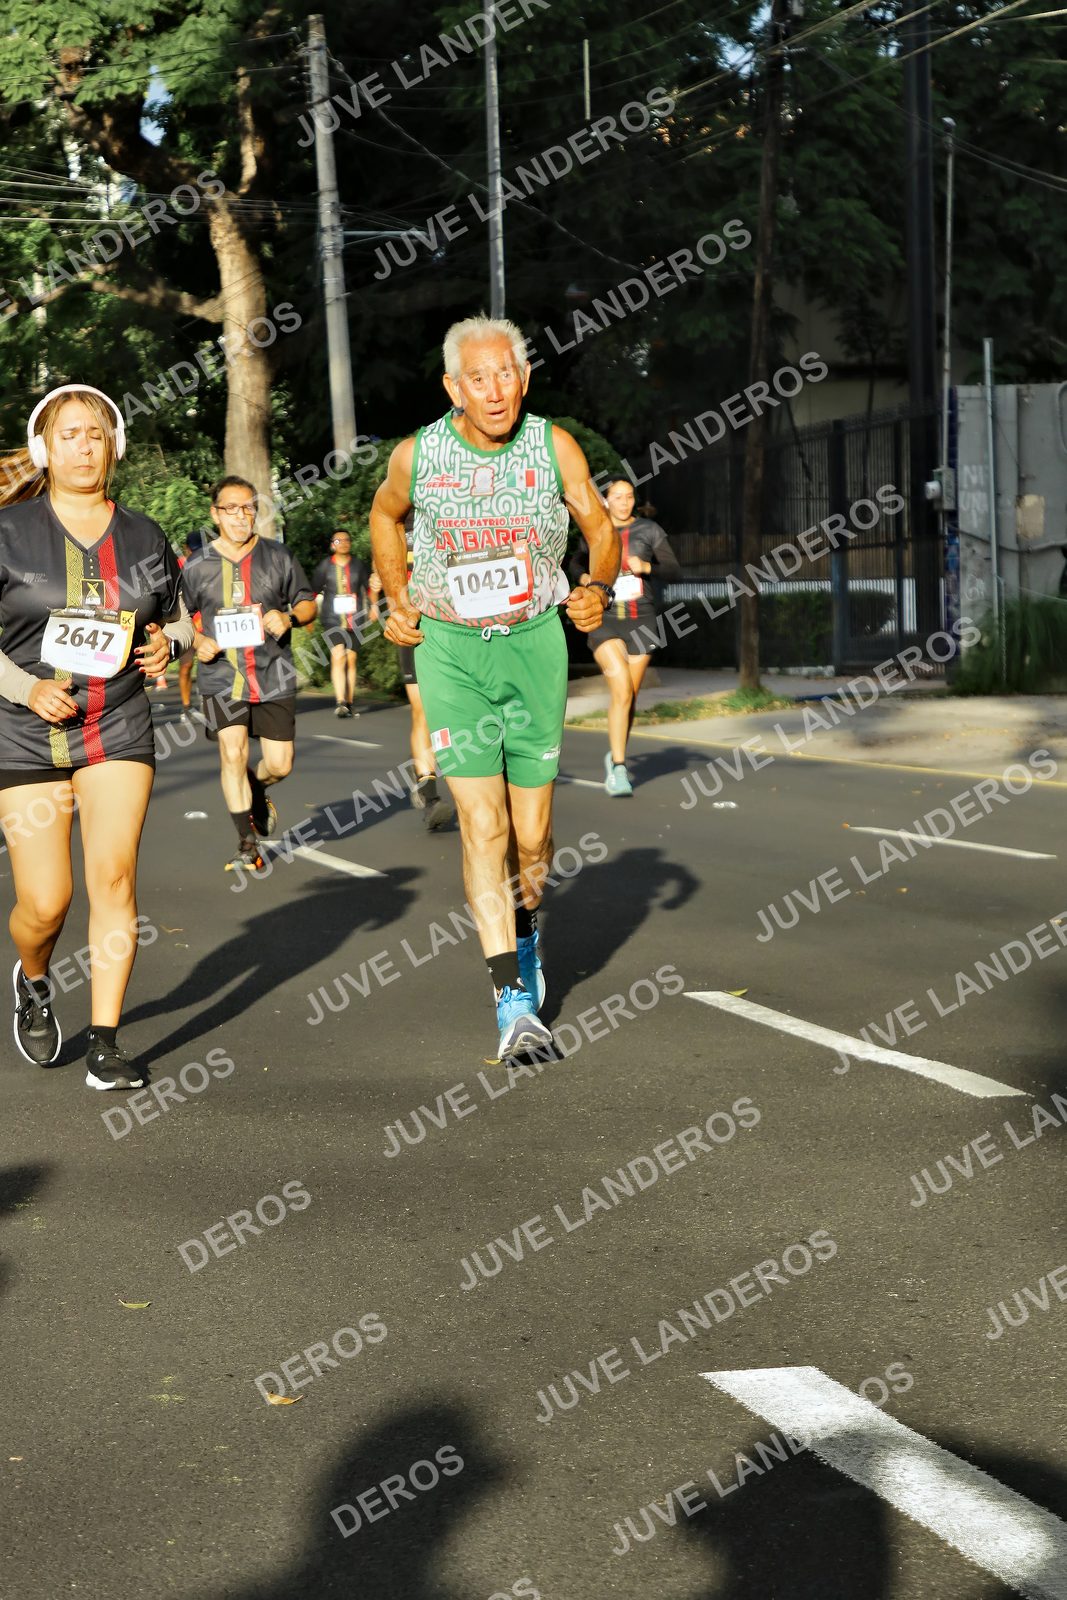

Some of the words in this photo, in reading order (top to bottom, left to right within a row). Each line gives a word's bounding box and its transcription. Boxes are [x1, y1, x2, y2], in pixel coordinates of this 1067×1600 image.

[468, 517, 507, 527] PATRIO
[509, 516, 530, 526] 2025
[454, 566, 520, 595] 10421
[217, 618, 255, 633] 11161
[55, 624, 115, 651] 2647
